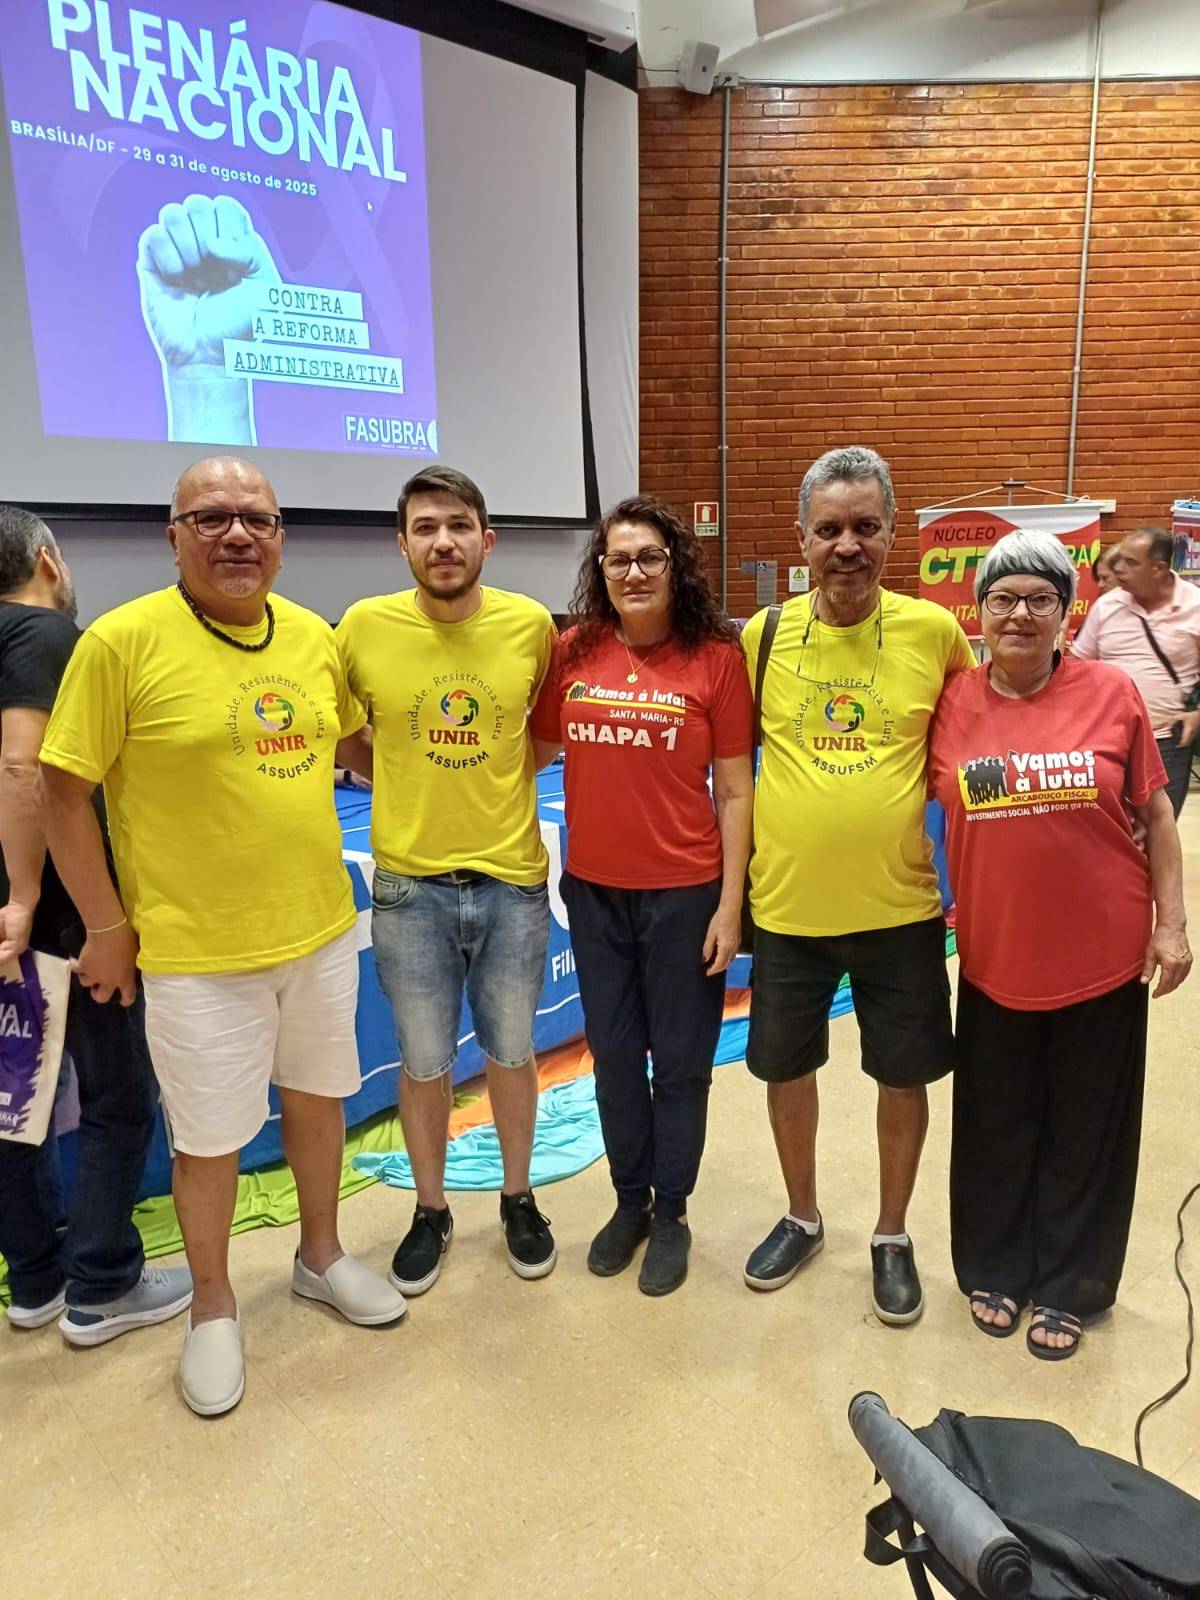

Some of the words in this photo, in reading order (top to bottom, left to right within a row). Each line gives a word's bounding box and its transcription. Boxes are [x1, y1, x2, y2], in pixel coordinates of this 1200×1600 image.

[47, 0, 367, 119] PLENÁRIA
[69, 49, 408, 184] NACIONAL
[10, 119, 116, 155] BRASÍLIA/DF
[133, 146, 152, 162] 29
[155, 153, 166, 165] a
[170, 154, 184, 169] 31
[188, 158, 207, 173] de
[210, 166, 261, 185] agosto
[264, 175, 282, 189] de
[284, 179, 317, 197] 2025
[268, 287, 344, 315] CONTRA
[254, 317, 266, 334] A
[272, 319, 358, 345] REFORMA
[233, 351, 399, 385] ADMINISTRATIVA
[345, 416, 427, 446] FASUBRA
[933, 526, 997, 542] NÚCLEO
[239, 674, 307, 699] Resistência
[432, 669, 497, 702] Resistência
[494, 703, 503, 711] e
[588, 684, 634, 701] Vamos
[638, 689, 648, 702] à
[652, 689, 686, 708] luta!
[609, 709, 637, 720] SANTA
[881, 708, 890, 716] e
[254, 734, 307, 756] UNIR
[428, 729, 480, 746] UNIR
[567, 722, 653, 748] CHAPA
[660, 726, 678, 751] 1
[813, 736, 867, 752] UNIR
[256, 752, 318, 779] ASSUFSM
[425, 750, 489, 770] ASSUFSM
[811, 756, 878, 776] ASSUFSM
[1010, 749, 1096, 773] Vamos
[1015, 773, 1031, 793] à
[1038, 765, 1096, 790] luta!
[1010, 791, 1062, 803] ARCABOUÇO
[1063, 790, 1089, 799] FISCAL
[966, 810, 1008, 821] INVESTIMENTO
[1008, 807, 1032, 818] SOCIAL
[1032, 803, 1050, 815] NÃO
[1050, 804, 1069, 812] PODE
